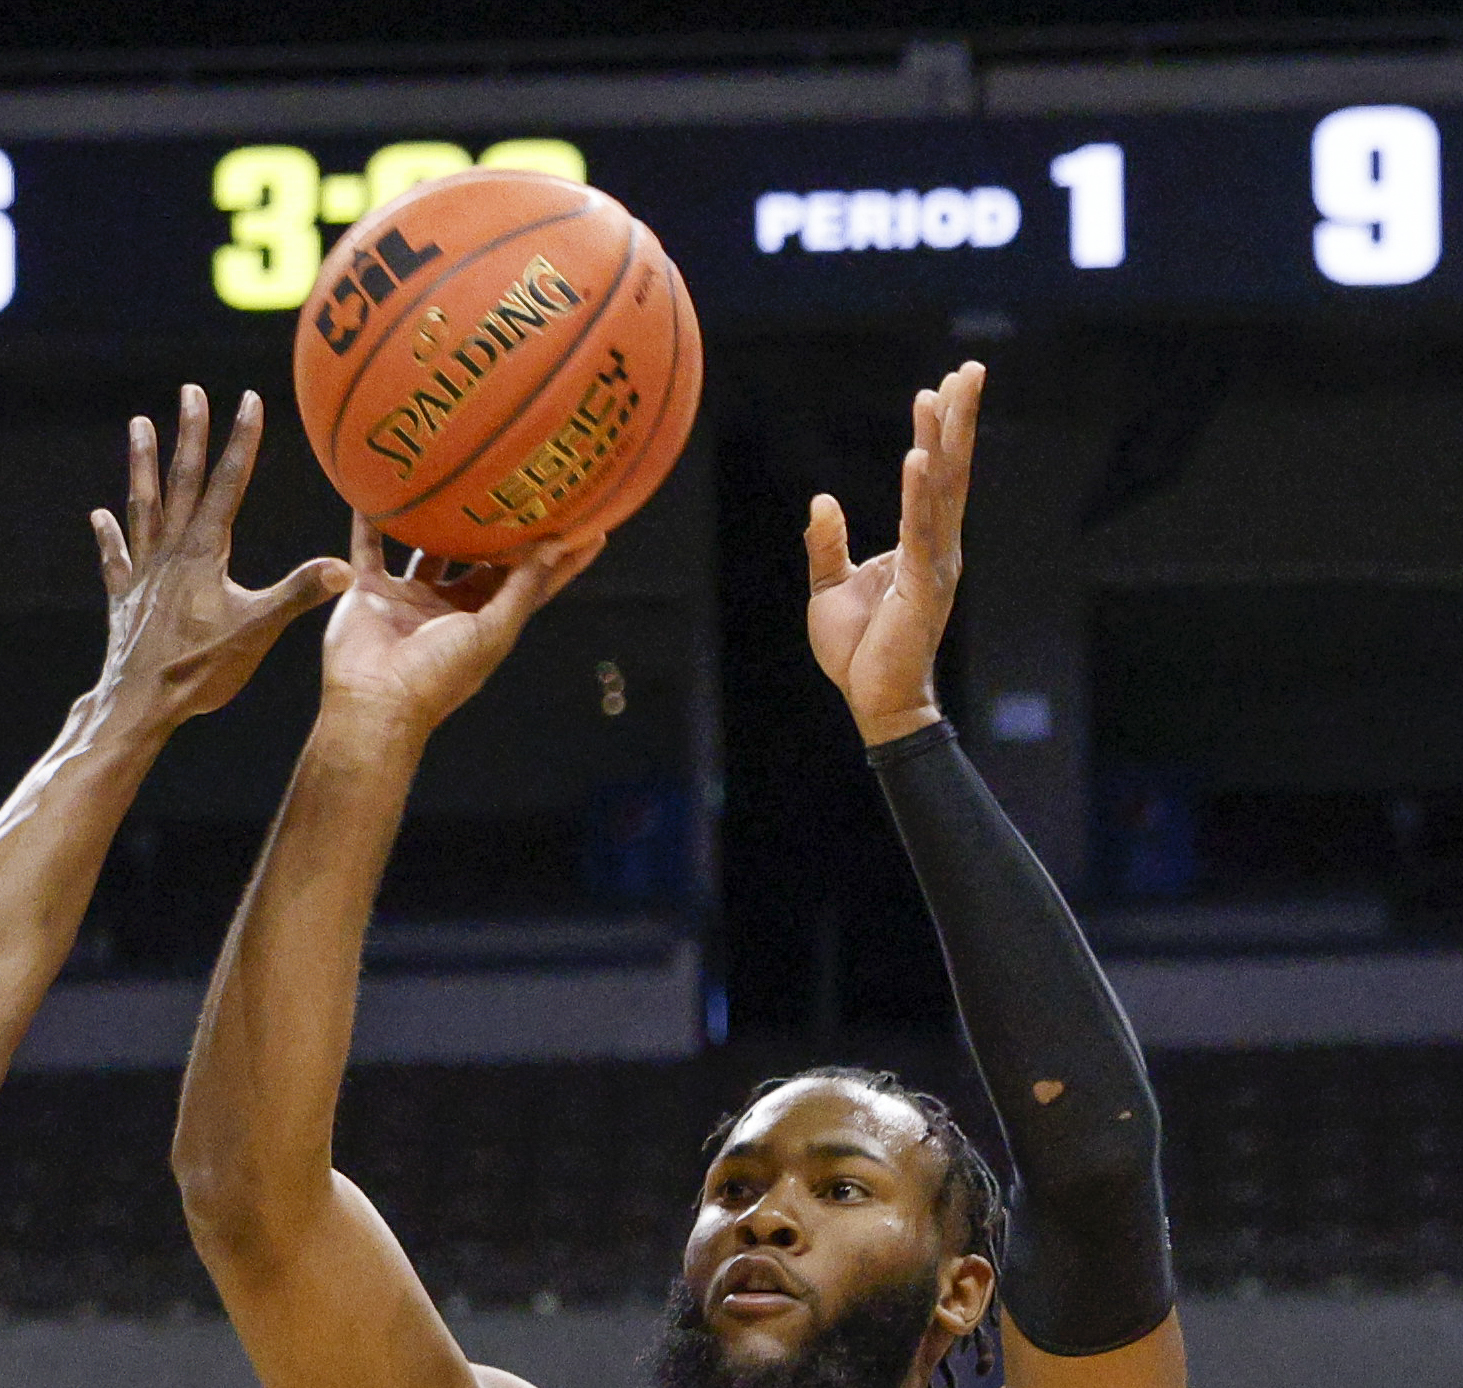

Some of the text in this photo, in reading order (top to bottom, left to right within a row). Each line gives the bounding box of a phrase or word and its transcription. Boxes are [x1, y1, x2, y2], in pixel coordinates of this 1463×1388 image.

[755, 142, 1127, 270] PERIOD 1
[1311, 104, 1443, 287] 9
[365, 253, 584, 480] SPALDING
